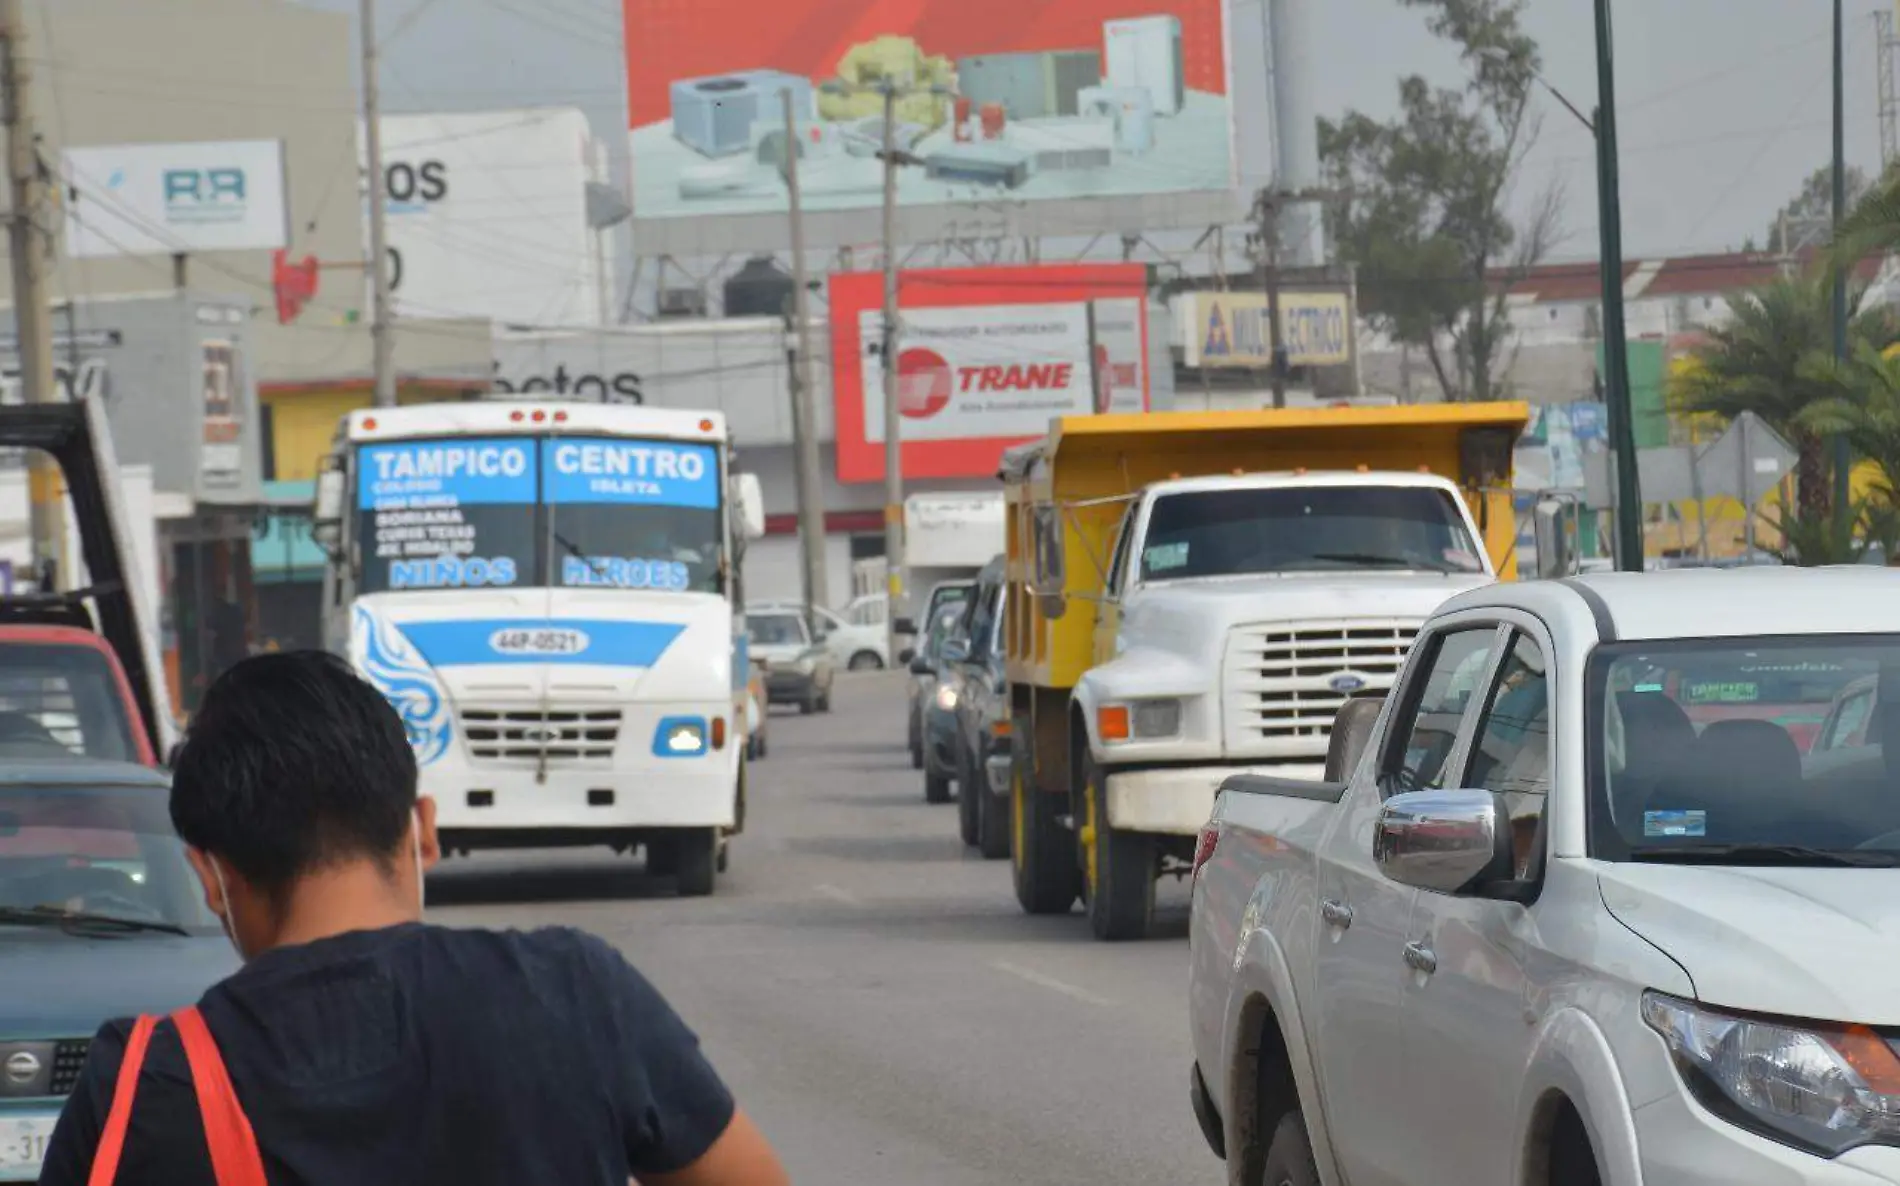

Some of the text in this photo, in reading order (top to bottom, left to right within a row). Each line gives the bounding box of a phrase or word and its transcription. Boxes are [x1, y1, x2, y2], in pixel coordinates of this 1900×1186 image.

[956, 362, 1073, 393] TRANE
[372, 444, 704, 481] TAMPICO CENTRO
[589, 479, 662, 495] ISLETA
[375, 510, 464, 527] SORIANA
[388, 553, 690, 592] NIÑOS HEROES
